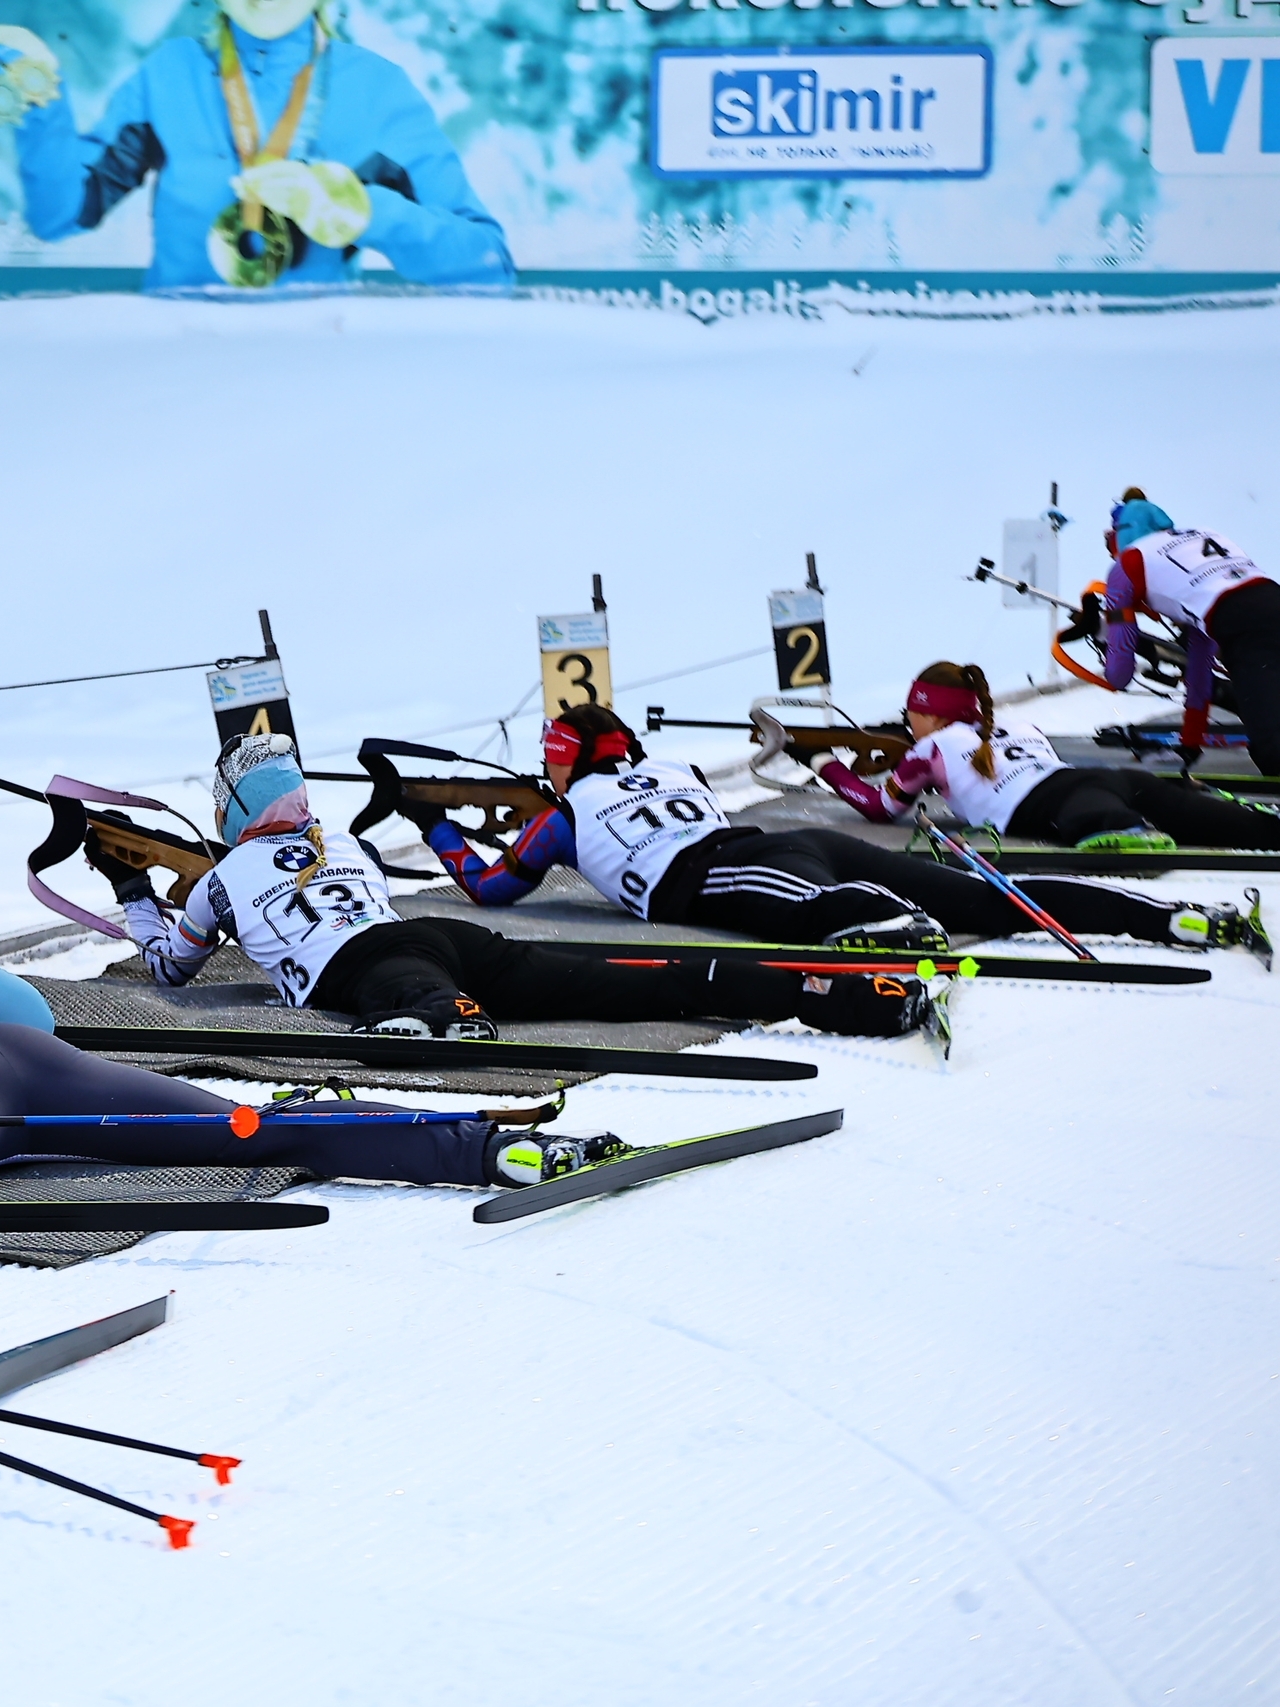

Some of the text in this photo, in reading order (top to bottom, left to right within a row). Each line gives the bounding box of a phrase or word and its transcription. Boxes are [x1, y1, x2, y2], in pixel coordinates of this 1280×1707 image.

[713, 74, 937, 135] skimir
[1202, 537, 1231, 559] 4
[786, 627, 824, 688] 2
[556, 654, 597, 710] 3
[626, 799, 706, 829] 10
[275, 846, 310, 860] BMW
[252, 877, 298, 908] СЕВЕРН
[283, 883, 365, 925] 13
